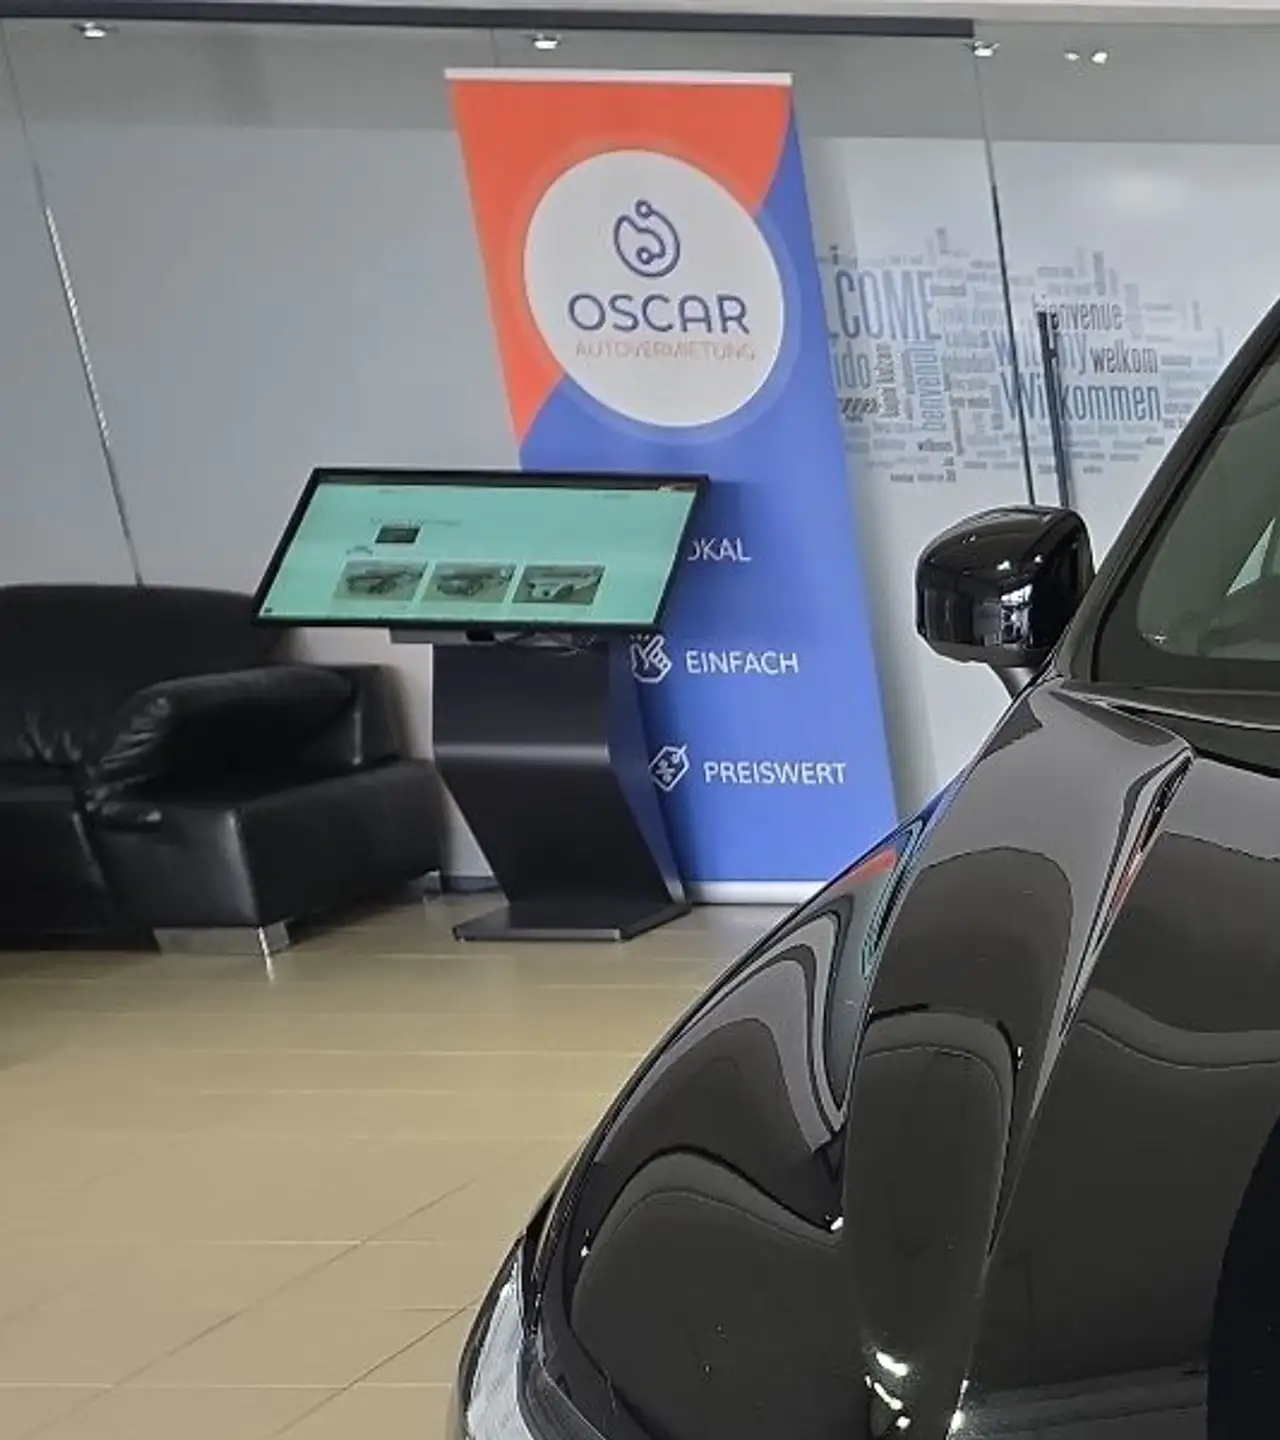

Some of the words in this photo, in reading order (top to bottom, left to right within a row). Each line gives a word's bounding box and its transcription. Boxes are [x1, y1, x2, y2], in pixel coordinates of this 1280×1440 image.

[568, 293, 750, 335] OSCAR
[829, 269, 942, 341] COME
[575, 338, 756, 362] AUTOVERMIETUNG
[1001, 372, 1162, 422] Wikommen
[685, 650, 800, 675] EINFACH
[703, 761, 847, 785] PREISWERT
